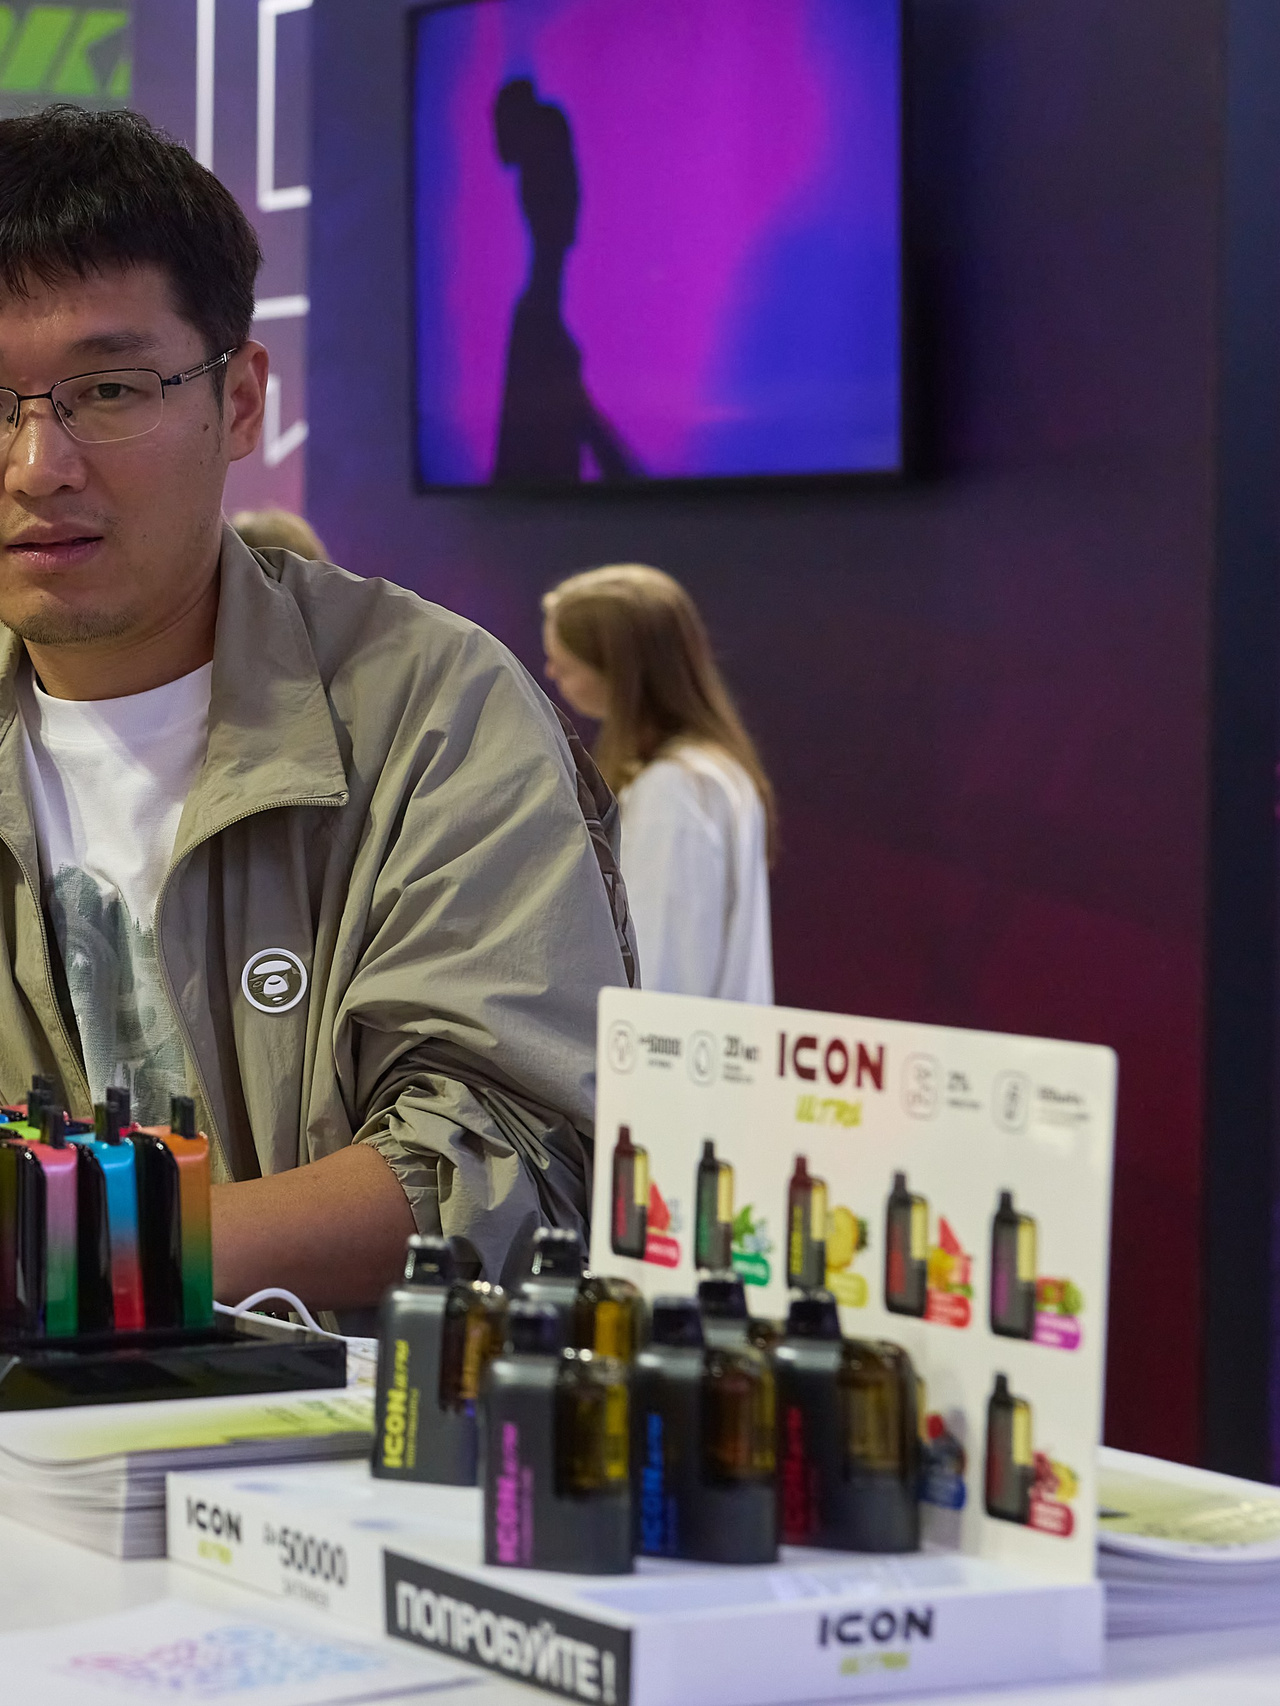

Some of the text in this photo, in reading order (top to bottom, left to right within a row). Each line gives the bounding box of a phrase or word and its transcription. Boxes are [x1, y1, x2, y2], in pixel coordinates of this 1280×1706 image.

[777, 1031, 887, 1091] ICON
[383, 1388, 407, 1469] ICON
[185, 1495, 243, 1545] ICON
[278, 1526, 347, 1588] 50000
[394, 1578, 618, 1706] ПОПРОБУЙТЕ!
[818, 1604, 935, 1648] ICON
